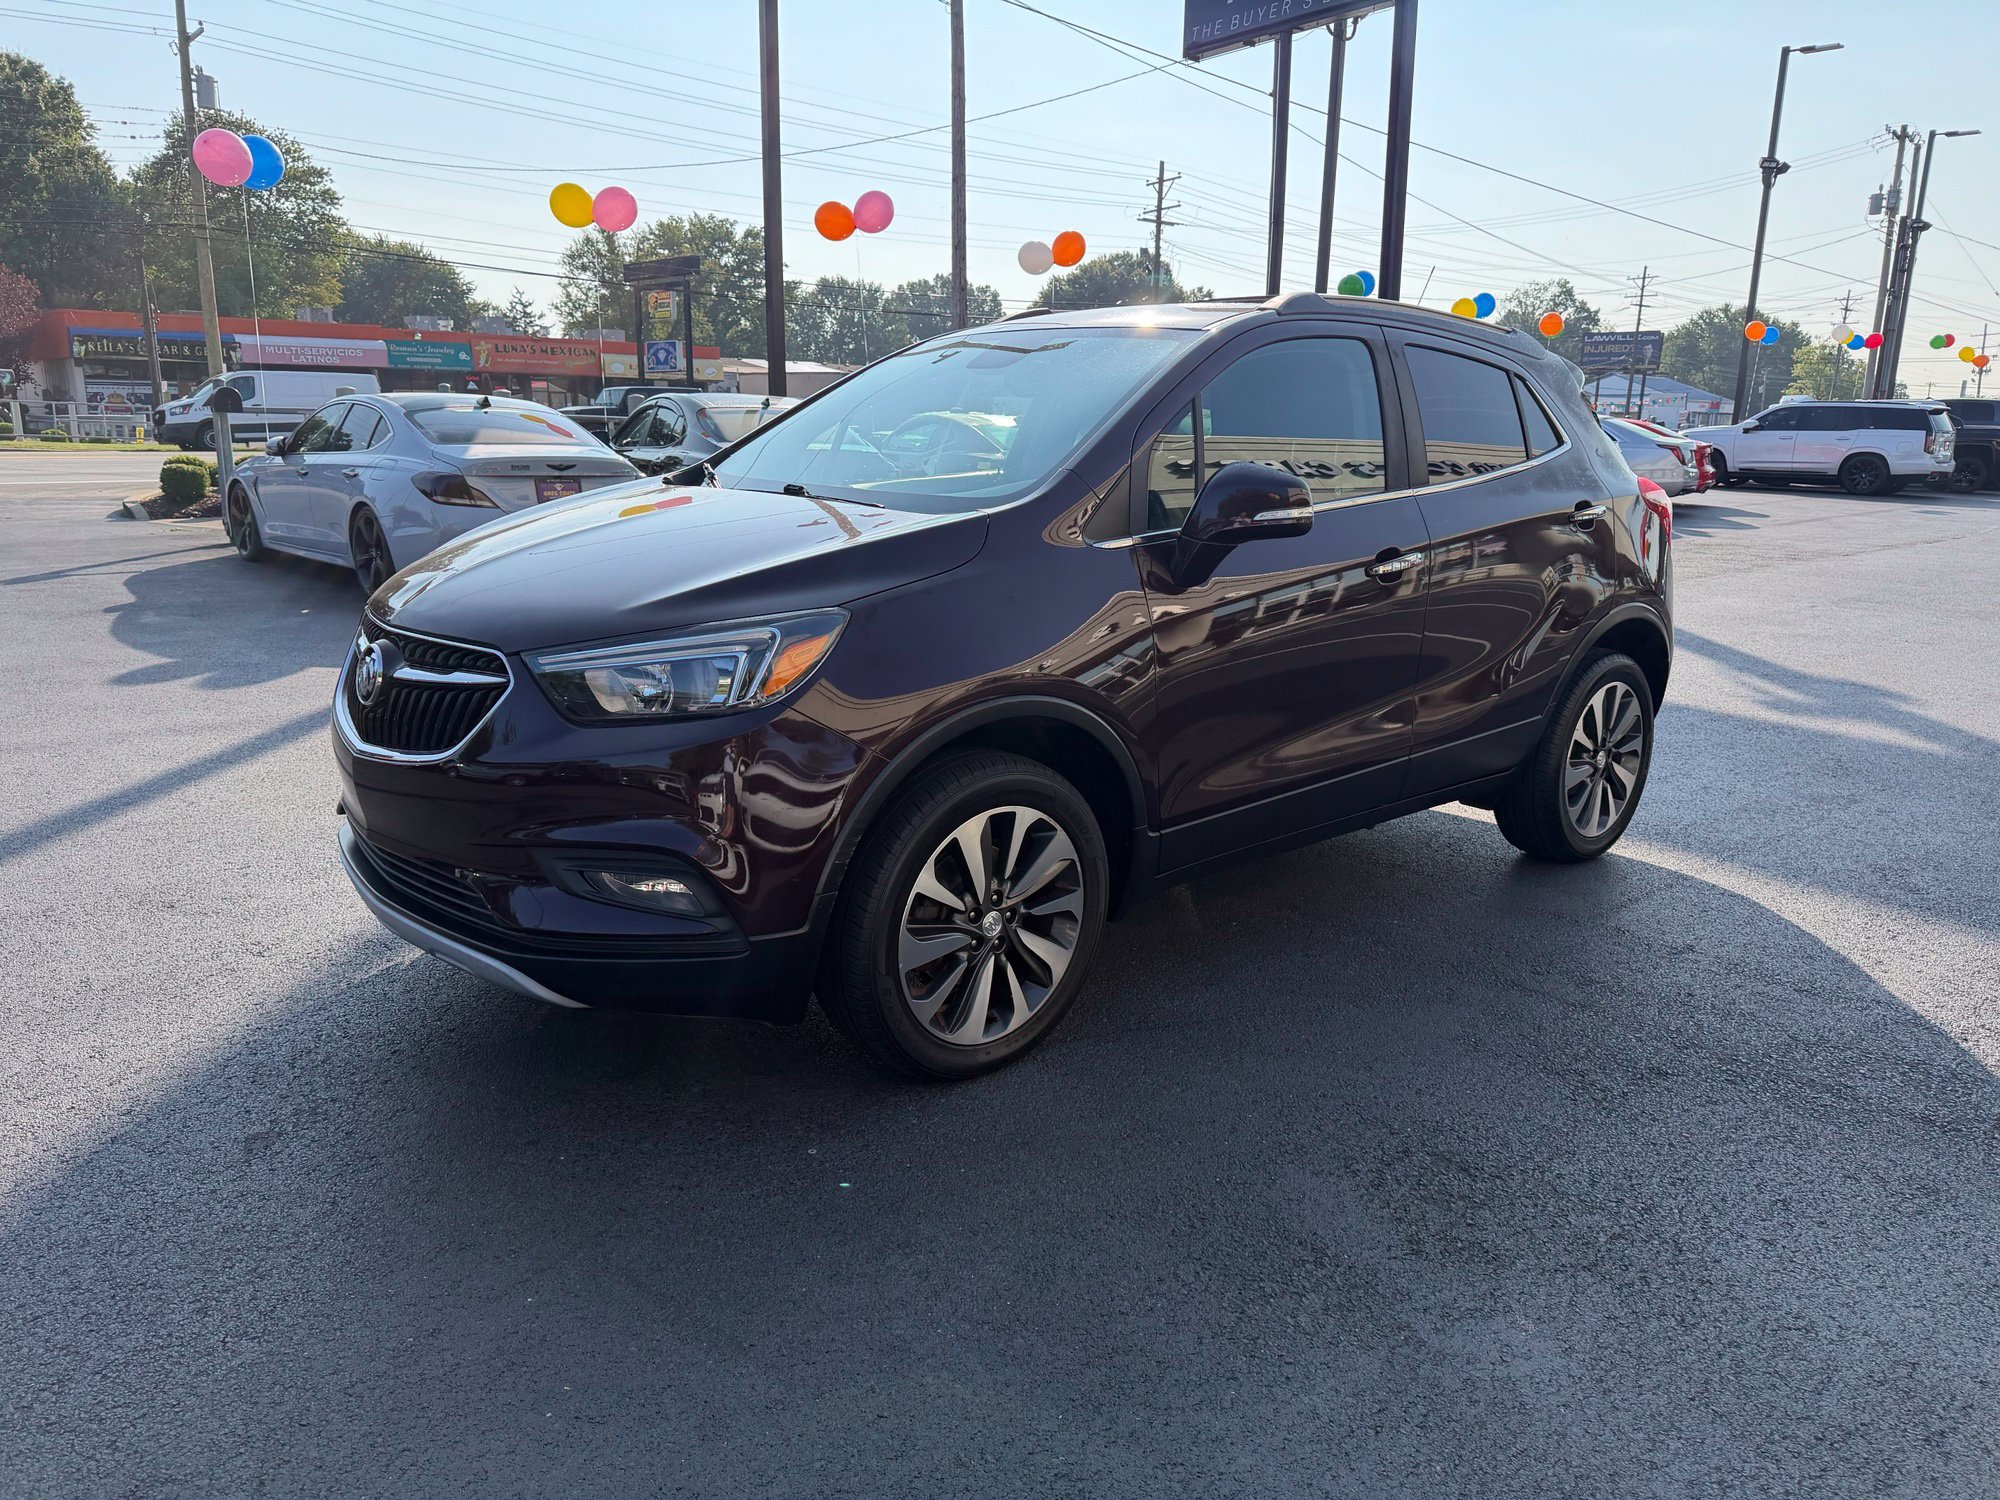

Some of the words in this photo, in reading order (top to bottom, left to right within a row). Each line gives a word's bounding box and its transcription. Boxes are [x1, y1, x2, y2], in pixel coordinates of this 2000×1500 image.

[1192, 19, 1223, 41] THE
[265, 345, 364, 357] MULTI-SERVICIOS
[494, 343, 536, 355] LUNA'S
[540, 345, 596, 358] MEXICAN
[291, 355, 340, 364] LATINOS
